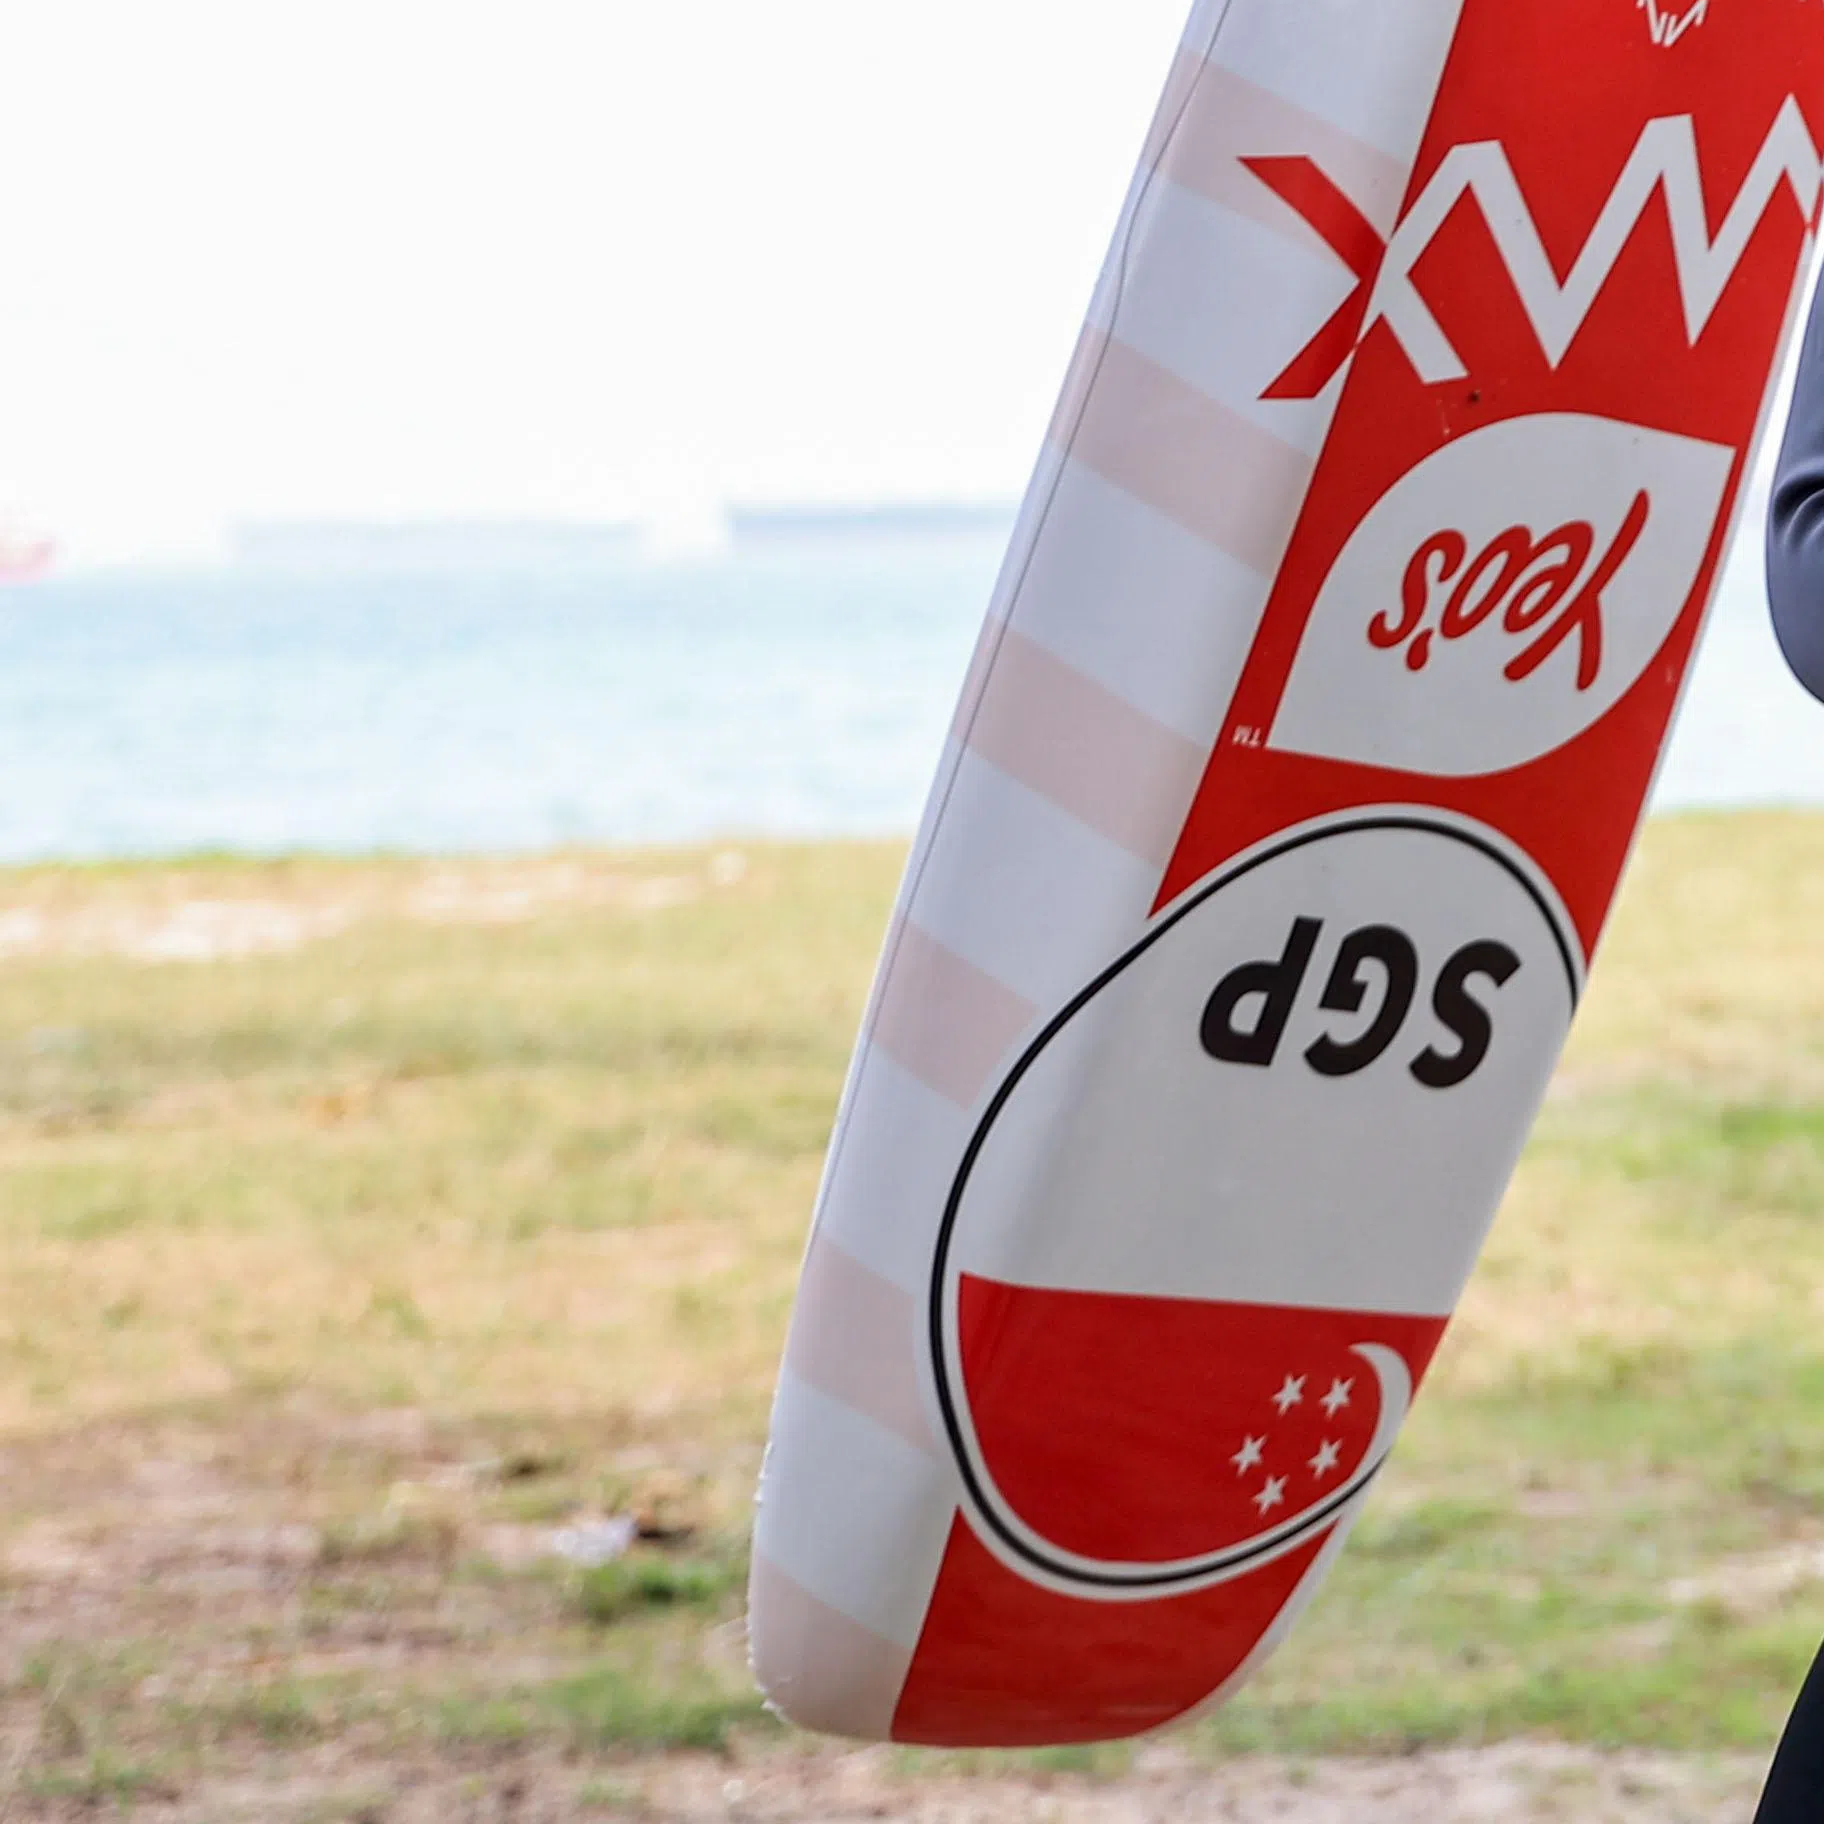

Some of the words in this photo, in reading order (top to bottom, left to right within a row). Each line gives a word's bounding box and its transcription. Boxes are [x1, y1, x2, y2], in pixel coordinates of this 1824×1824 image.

[1367, 488, 1650, 692] Yeo's
[1232, 724, 1263, 747] TM
[1199, 914, 1521, 1088] SGP
